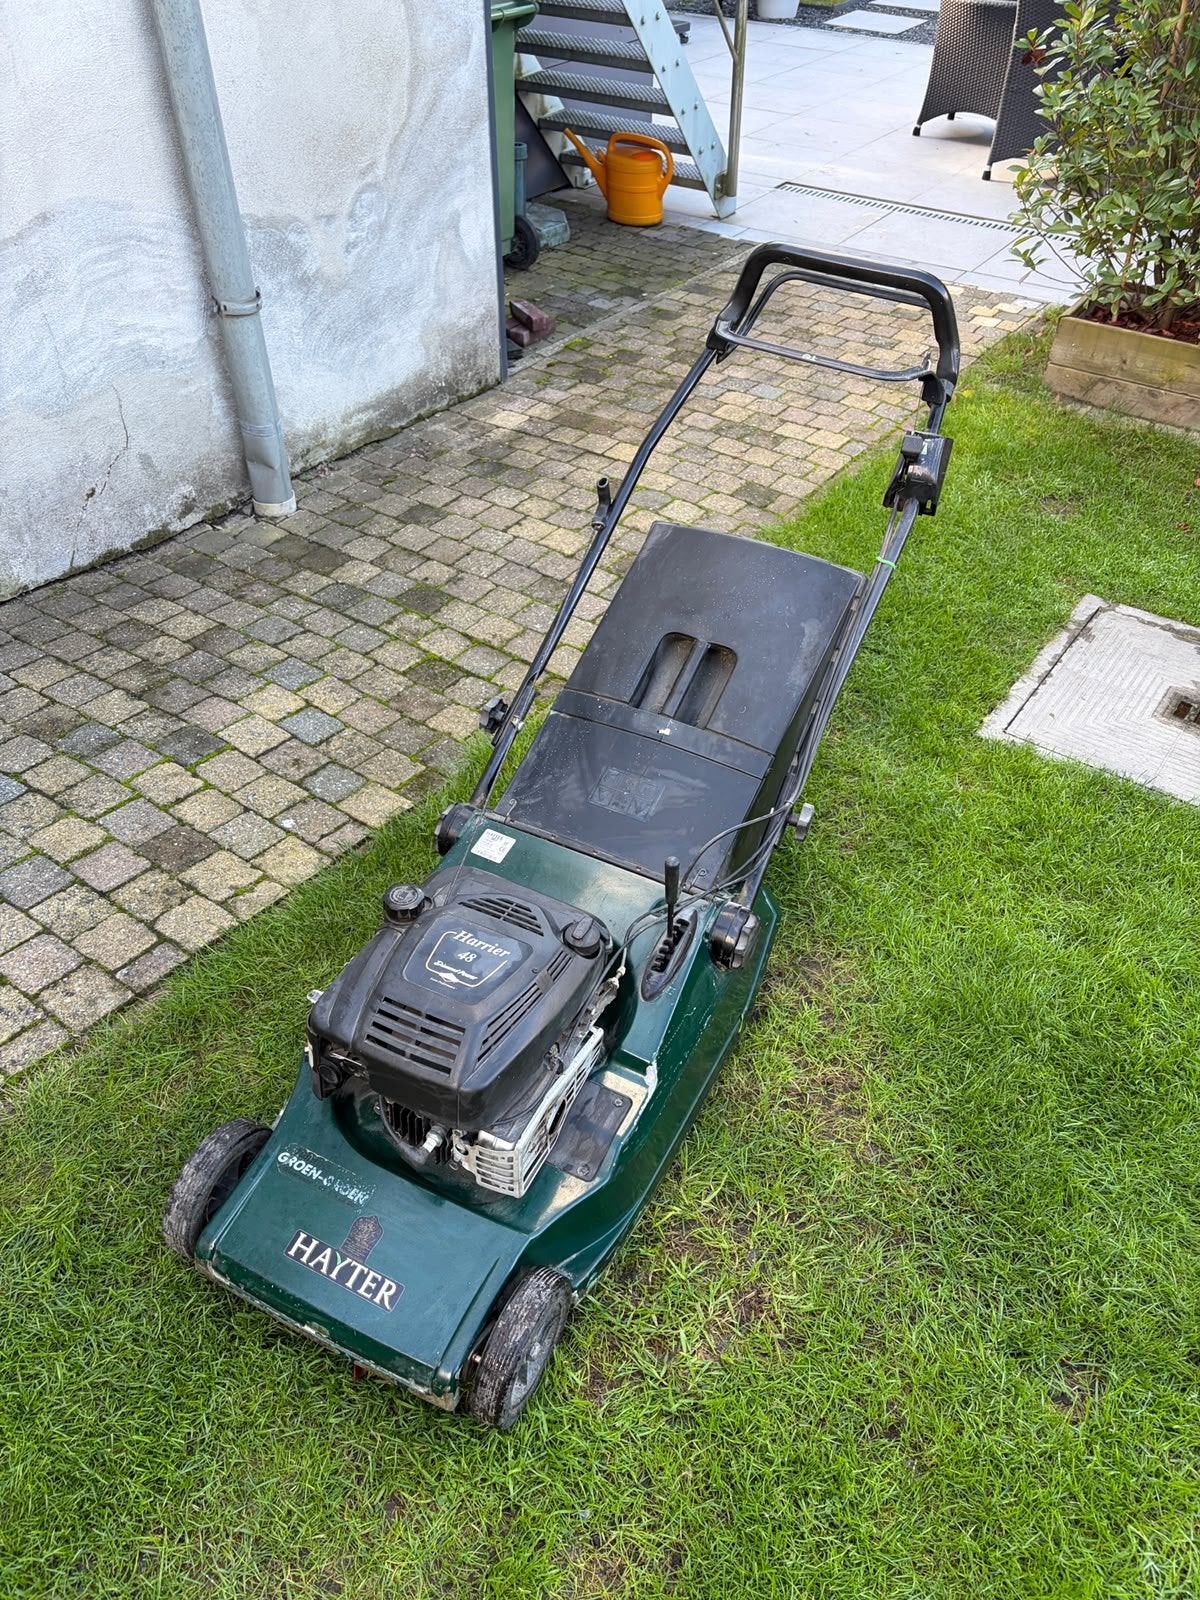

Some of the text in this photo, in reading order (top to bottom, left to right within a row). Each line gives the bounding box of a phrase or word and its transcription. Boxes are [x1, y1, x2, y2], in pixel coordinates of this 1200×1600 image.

[453, 930, 511, 957] Harrier
[457, 951, 477, 963] 48
[287, 1231, 397, 1310] HAYTER
